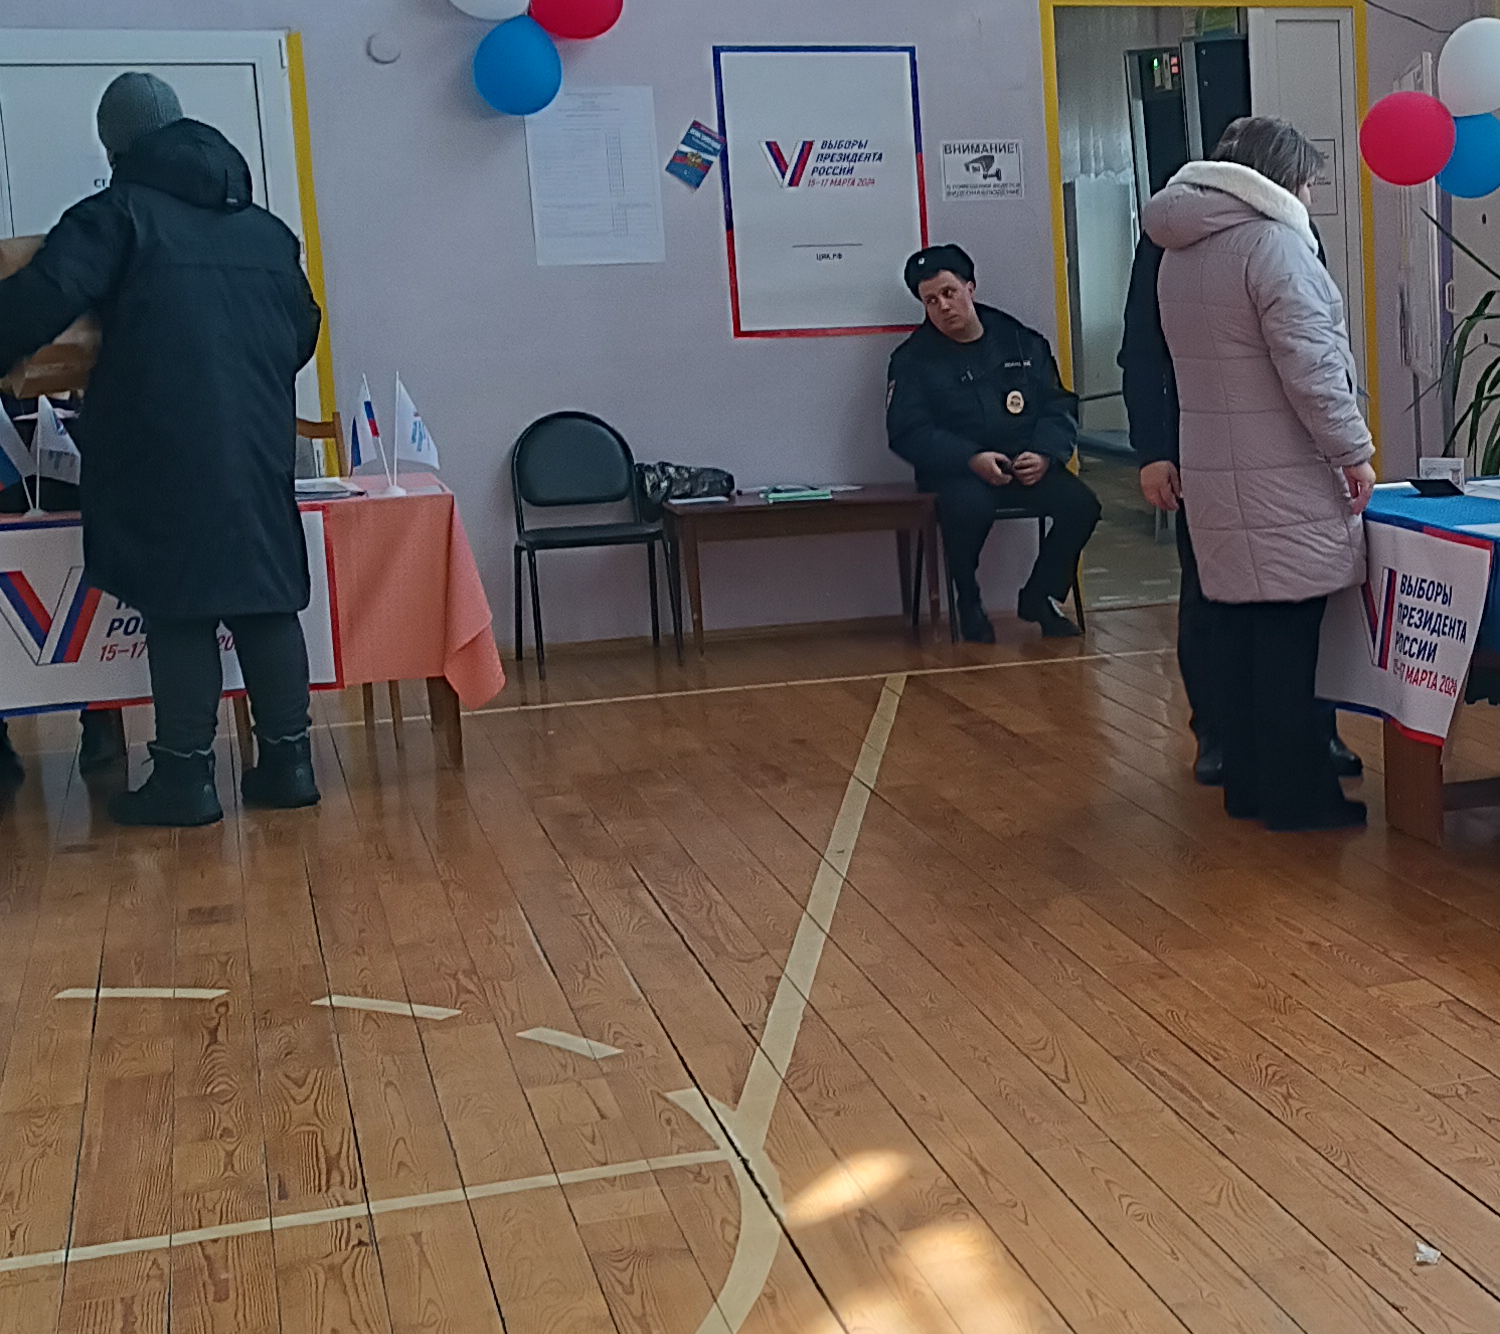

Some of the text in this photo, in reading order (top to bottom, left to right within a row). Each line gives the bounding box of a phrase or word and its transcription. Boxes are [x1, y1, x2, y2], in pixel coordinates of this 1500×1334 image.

[820, 139, 869, 150] ВЫБОРЫ
[943, 143, 1019, 155] ВНИМАНИЕ!
[815, 152, 883, 164] ПРЕЗИДЕНТА
[810, 166, 855, 177] РОССИИ
[1400, 573, 1453, 607] ВЫБОРЫ
[1398, 602, 1468, 644] ПРЕЗИДЕНТА
[1395, 631, 1438, 664] РОССИИ
[1405, 665, 1438, 691] МАРТА
[1438, 674, 1458, 698] 2024
